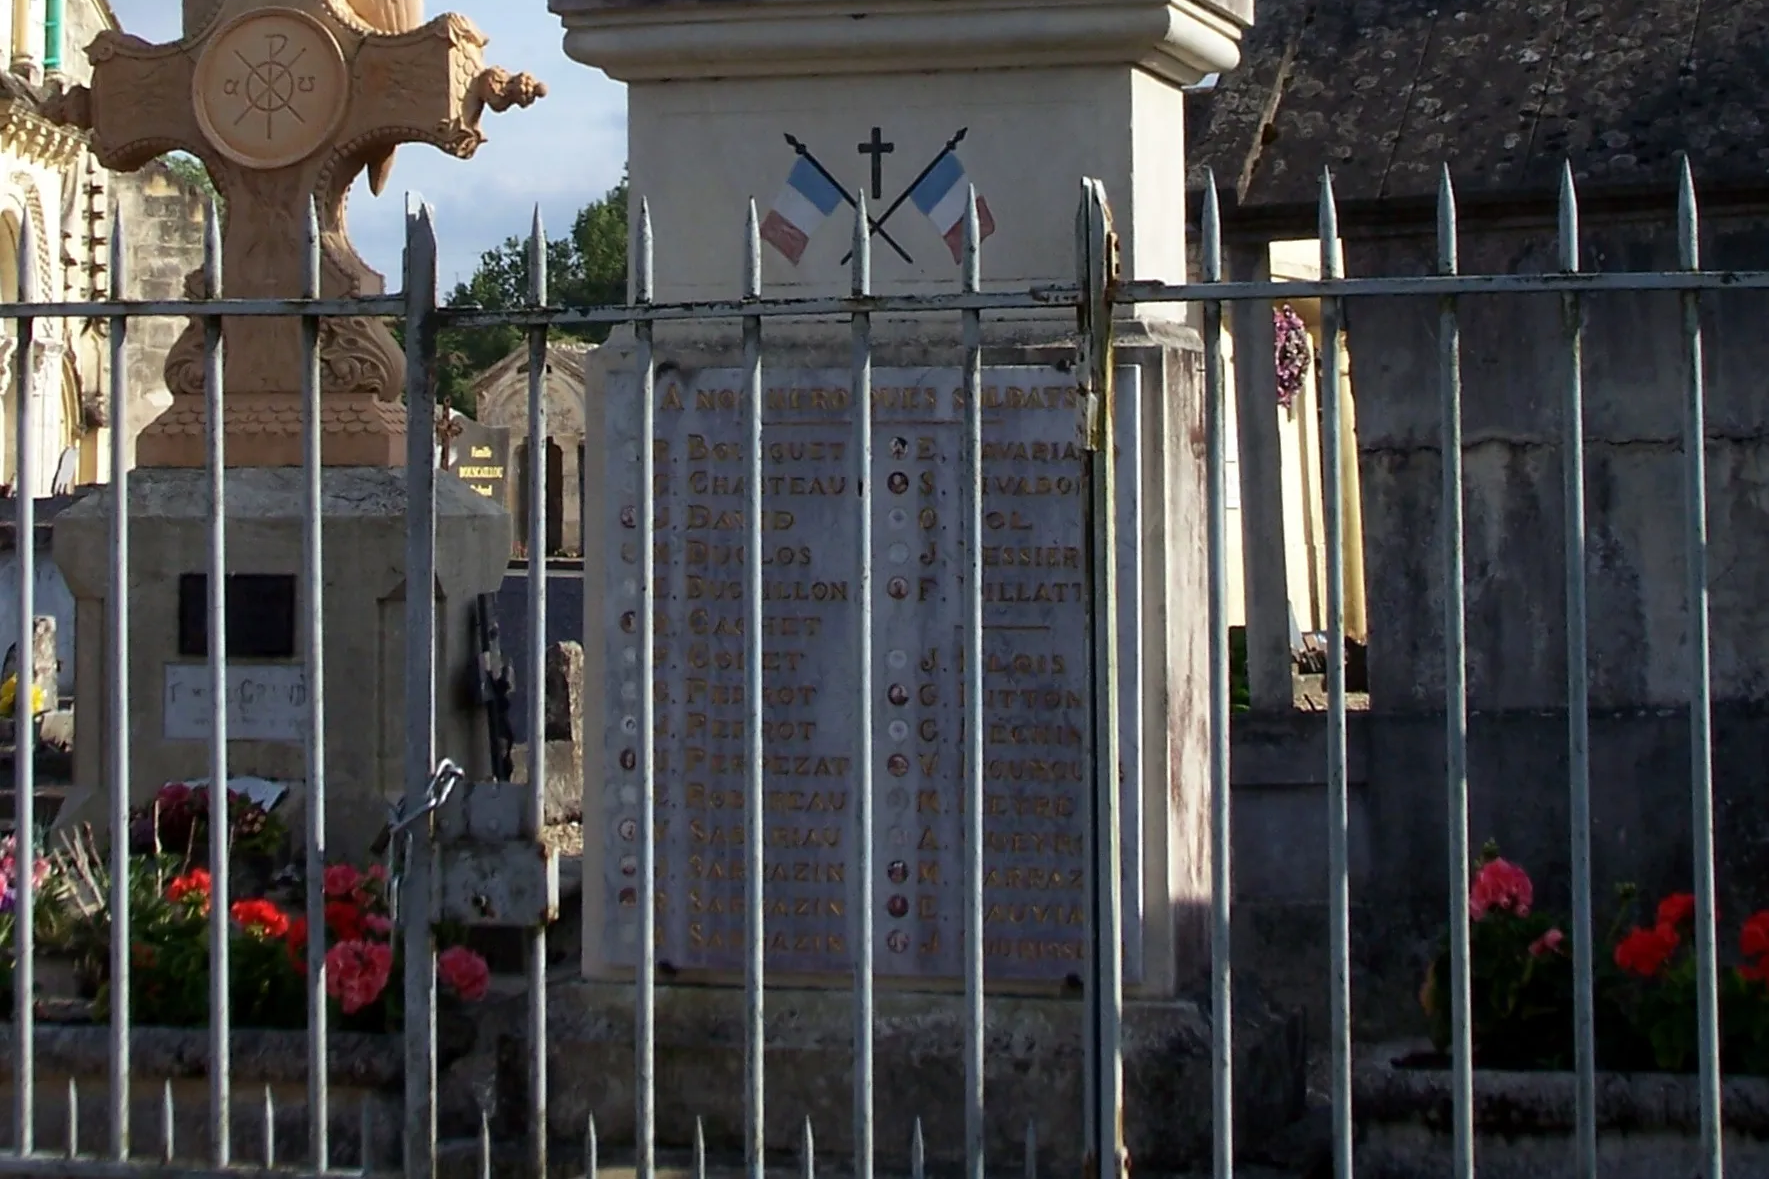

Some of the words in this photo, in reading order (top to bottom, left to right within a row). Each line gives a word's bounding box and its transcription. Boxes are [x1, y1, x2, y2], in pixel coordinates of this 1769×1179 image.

[660, 381, 686, 411] A
[766, 385, 938, 410] HEROUES
[952, 384, 1079, 410] SLDATS
[687, 433, 847, 465] BOUQUET
[689, 470, 848, 496] CHATEAU
[958, 507, 1034, 532] OL
[956, 539, 1081, 569] ESSIER
[957, 645, 1067, 674] LOIS
[957, 682, 1083, 710] ITTON
[688, 818, 843, 848] SABRIAU
[687, 853, 846, 883] SARAZIN
[687, 888, 847, 917] SARAZIN
